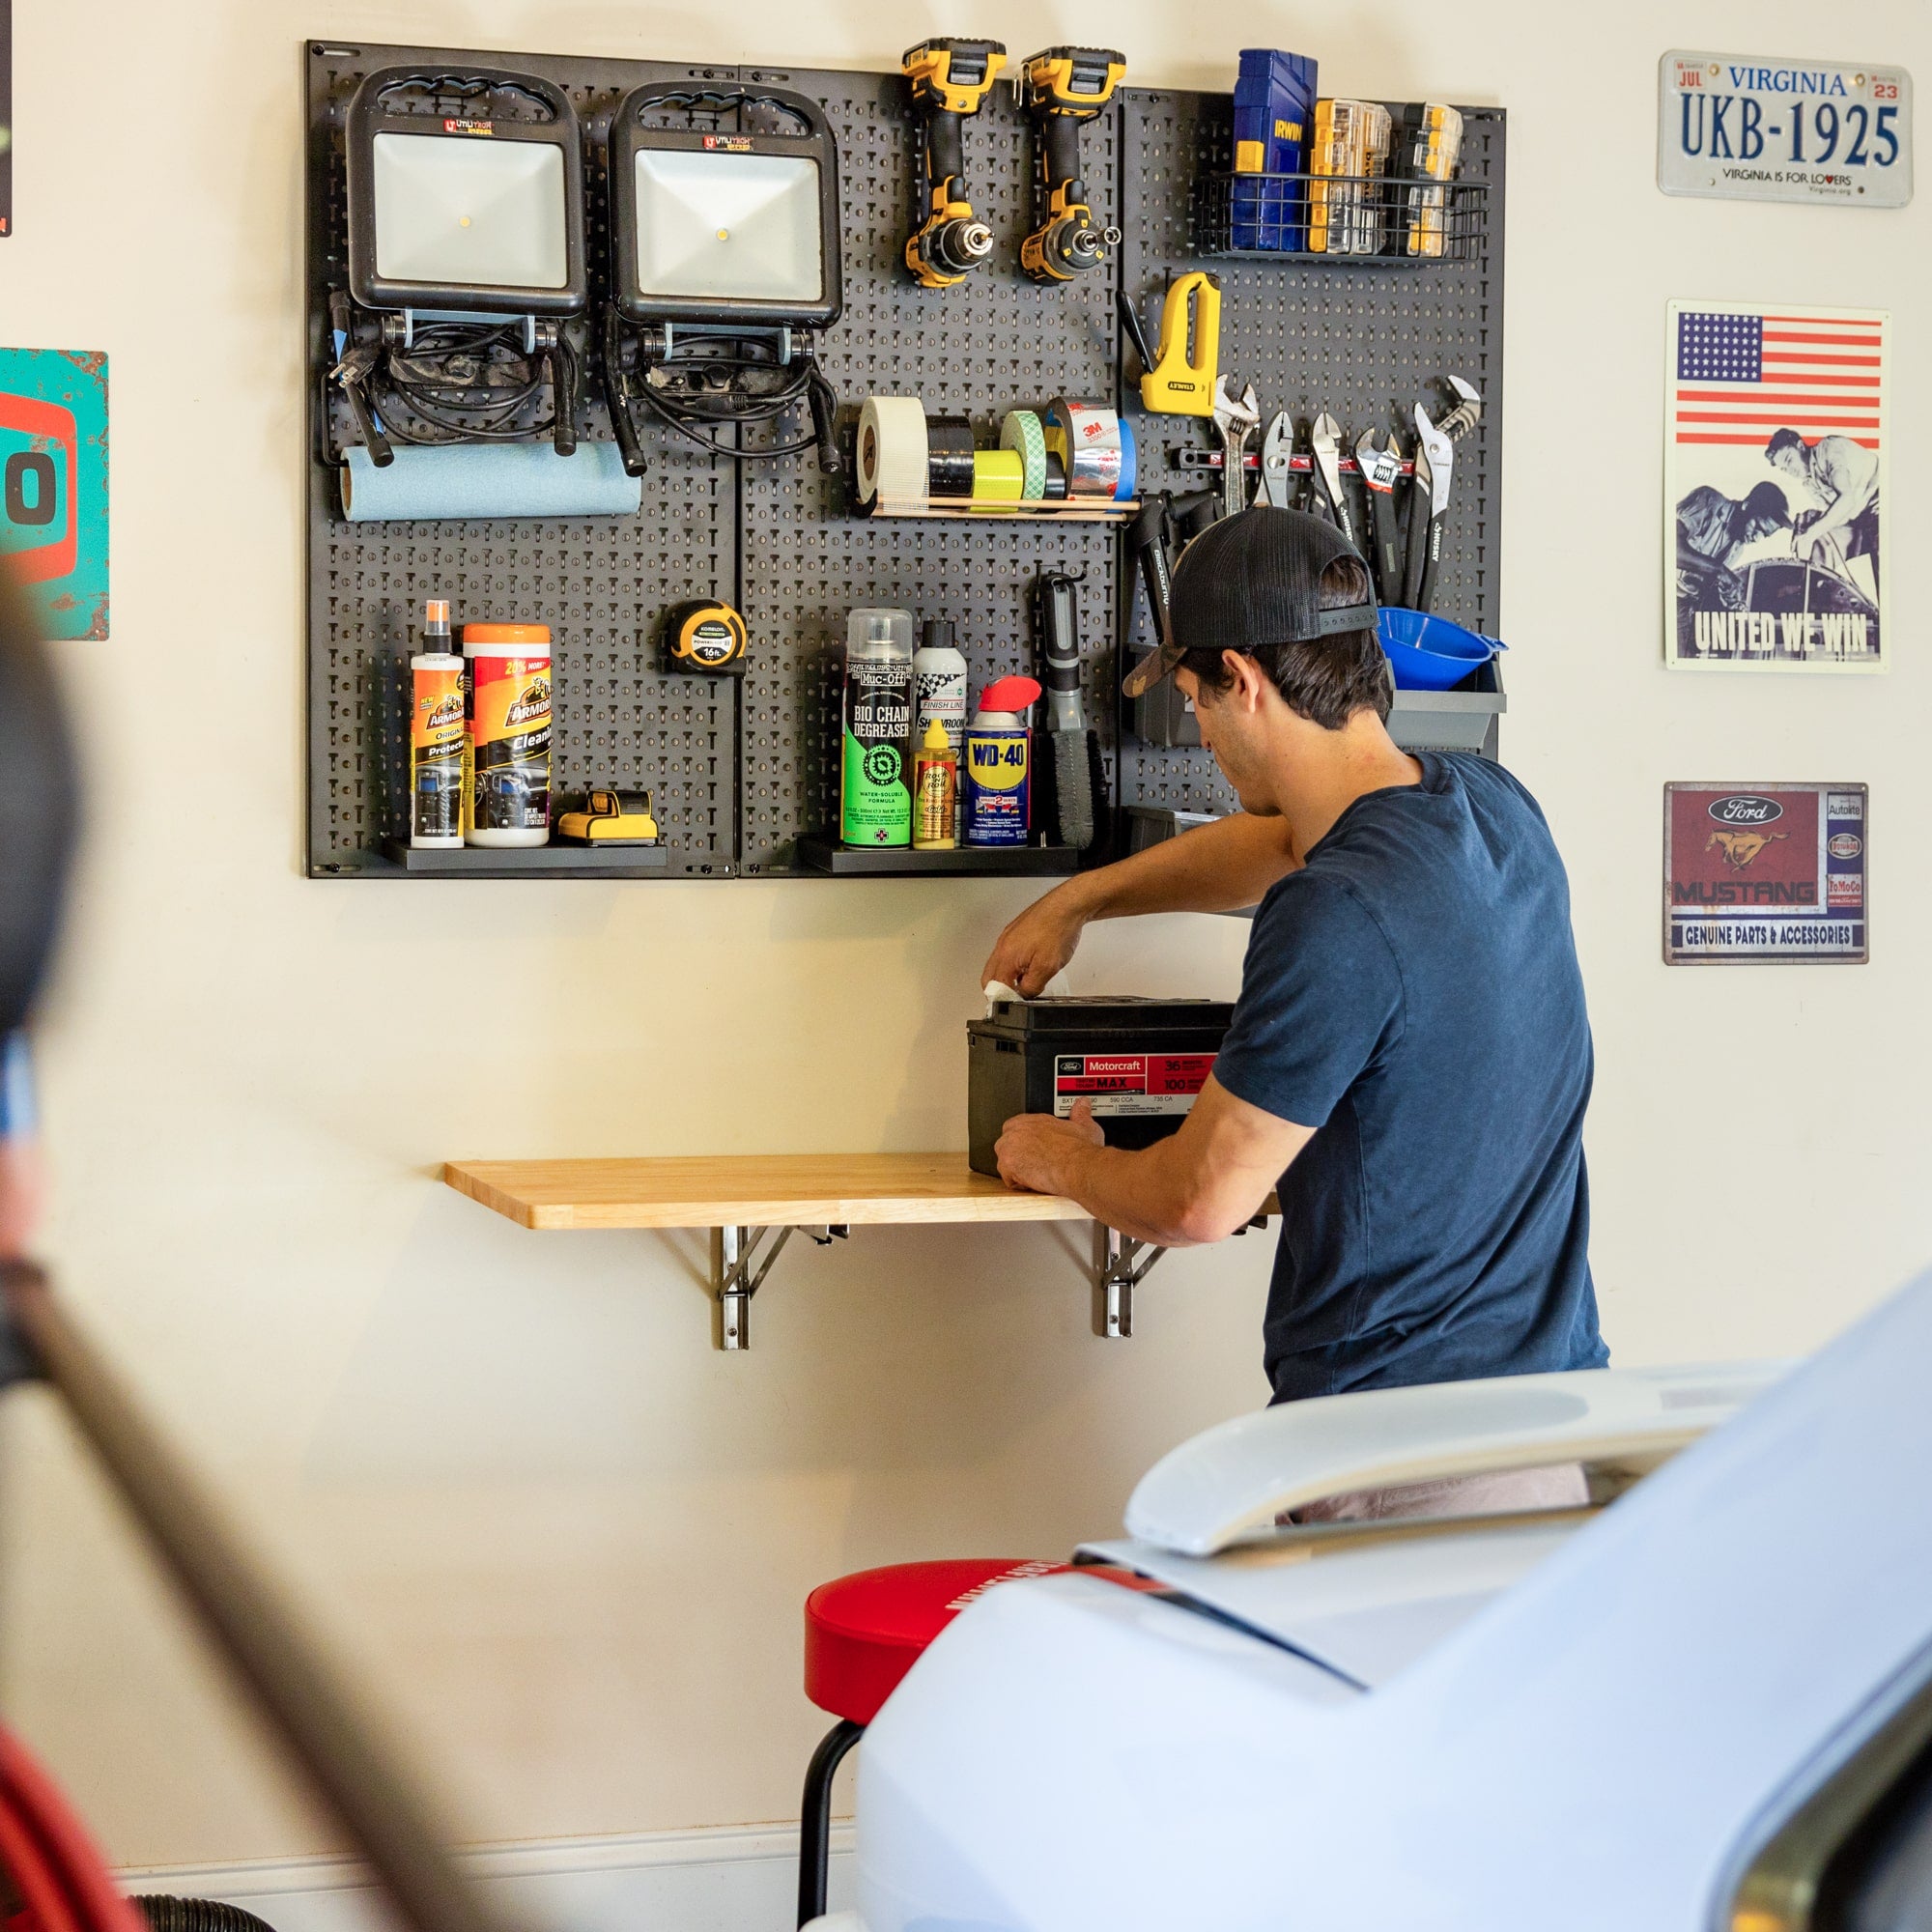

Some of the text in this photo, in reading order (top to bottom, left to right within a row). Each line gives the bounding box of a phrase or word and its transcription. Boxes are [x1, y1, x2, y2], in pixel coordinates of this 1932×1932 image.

[1679, 71, 1703, 87] JUL
[1729, 66, 1848, 96] VIRGINIA
[1874, 84, 1898, 99] 23
[1275, 119, 1303, 143] IRWIN
[1681, 93, 1899, 166] UKB-1925
[1722, 168, 1773, 182] VIRGINIA
[1775, 171, 1784, 182] IS
[1786, 172, 1809, 184] FOR
[1169, 383, 1195, 391] STANLEY
[1083, 422, 1103, 439] 3M
[1433, 528, 1443, 562] HUSKY
[1154, 549, 1169, 598] Blackburn
[1694, 611, 1867, 653] UNITED WE WIN
[703, 647, 714, 657] 16
[505, 660, 526, 675] 20%
[863, 672, 904, 684] Muc-Off
[854, 705, 909, 723] BIO CHAIN
[854, 723, 909, 738] DEGREASER
[972, 744, 1024, 767] WD-40
[995, 796, 1003, 805] 2
[1723, 799, 1768, 820] Ford
[1673, 881, 1815, 903] MUSTANG
[1830, 880, 1861, 893] FoMoCo
[1686, 925, 1851, 946] GENUINE PARTS & ACCESSORIES
[1089, 1061, 1141, 1070] Motorcraft
[1165, 1061, 1180, 1071] 36
[1096, 1077, 1127, 1088] MAX
[1165, 1079, 1185, 1090] 100
